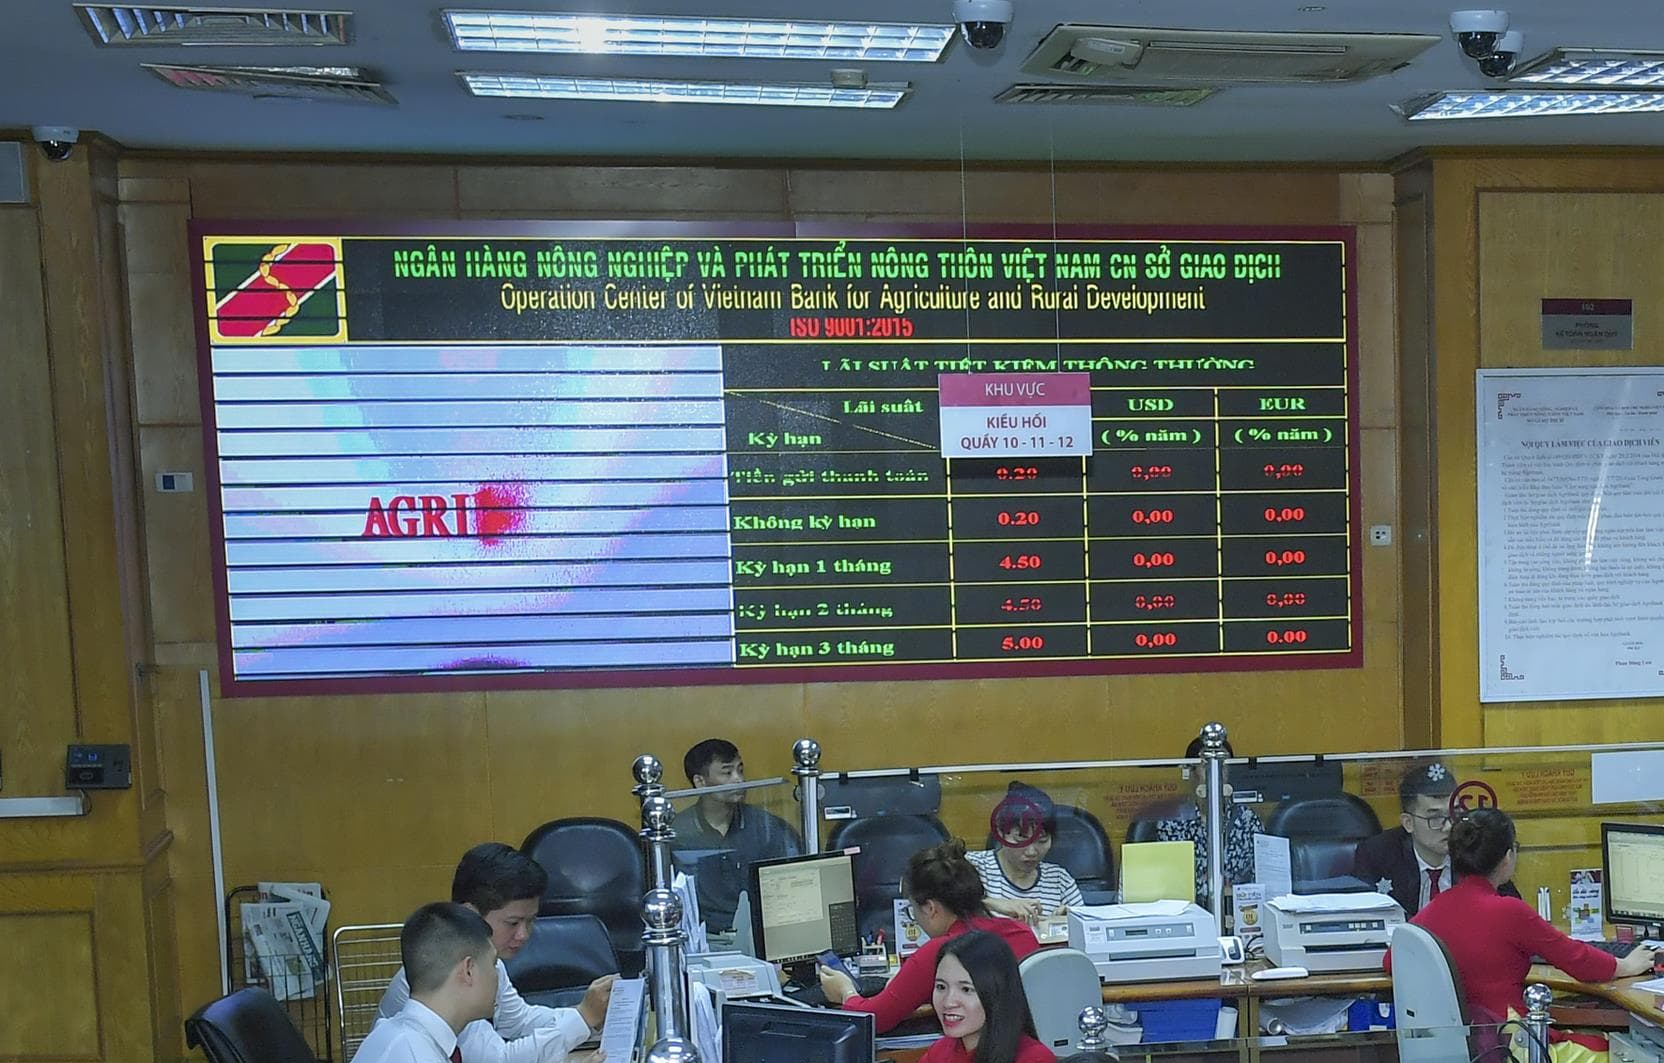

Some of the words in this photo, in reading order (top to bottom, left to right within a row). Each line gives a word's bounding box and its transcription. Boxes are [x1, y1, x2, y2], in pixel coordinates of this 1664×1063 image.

[394, 245, 456, 278] NGÂN
[465, 245, 527, 278] HÀNG
[536, 245, 598, 278] NÔNG
[608, 246, 689, 283] NGHIỆP
[697, 245, 725, 278] VÀ
[735, 246, 790, 278] PHÁT
[798, 241, 862, 278] TRIỂN
[871, 246, 929, 278] NÔNG
[938, 247, 993, 279] THÔN
[1002, 247, 1047, 283] VIỆT
[1056, 254, 1100, 279] NAM
[1110, 254, 1137, 279] CN
[1145, 245, 1171, 279] SỞ
[1180, 254, 1226, 279] GIAO
[1234, 254, 1281, 284] DỊCH
[500, 283, 595, 314] Operation
[604, 284, 668, 309] Center
[676, 284, 695, 309] of
[703, 283, 781, 309] Vietnam
[791, 284, 838, 310] Bank
[847, 284, 871, 310] for
[880, 284, 980, 314] Agriculture
[988, 285, 1021, 309] and
[1030, 284, 1078, 310] Rural
[1087, 285, 1205, 314] Development
[790, 318, 819, 336] ISO
[825, 317, 914, 337] 9001:2015
[985, 383, 1013, 396] KHU
[1017, 381, 1046, 398] VỰC
[843, 400, 875, 414] Lãi
[1128, 398, 1174, 411] USD
[1259, 398, 1306, 410] EUR
[1022, 413, 1047, 428] HỐI
[784, 431, 822, 448] hạn
[1145, 430, 1187, 442] năm
[1277, 428, 1318, 441] năm
[1003, 437, 1019, 449] 10
[1030, 437, 1045, 448] 11
[1058, 436, 1073, 448] 12
[997, 511, 1039, 525] 0.20
[1132, 510, 1174, 525] 0,00
[1264, 508, 1305, 522] 0,00
[733, 516, 803, 531] Không
[838, 515, 876, 529] hạn
[1000, 555, 1041, 569] 4.50
[1133, 553, 1175, 568] 0,00
[1265, 551, 1305, 566] 0,00
[772, 560, 809, 577] hạn
[816, 560, 826, 573] 1
[834, 559, 892, 576] tháng
[1002, 636, 1043, 650] 5.00
[1135, 632, 1177, 647] 0,00
[777, 641, 812, 658] hạn
[818, 641, 831, 655] 3
[837, 640, 894, 656] tháng
